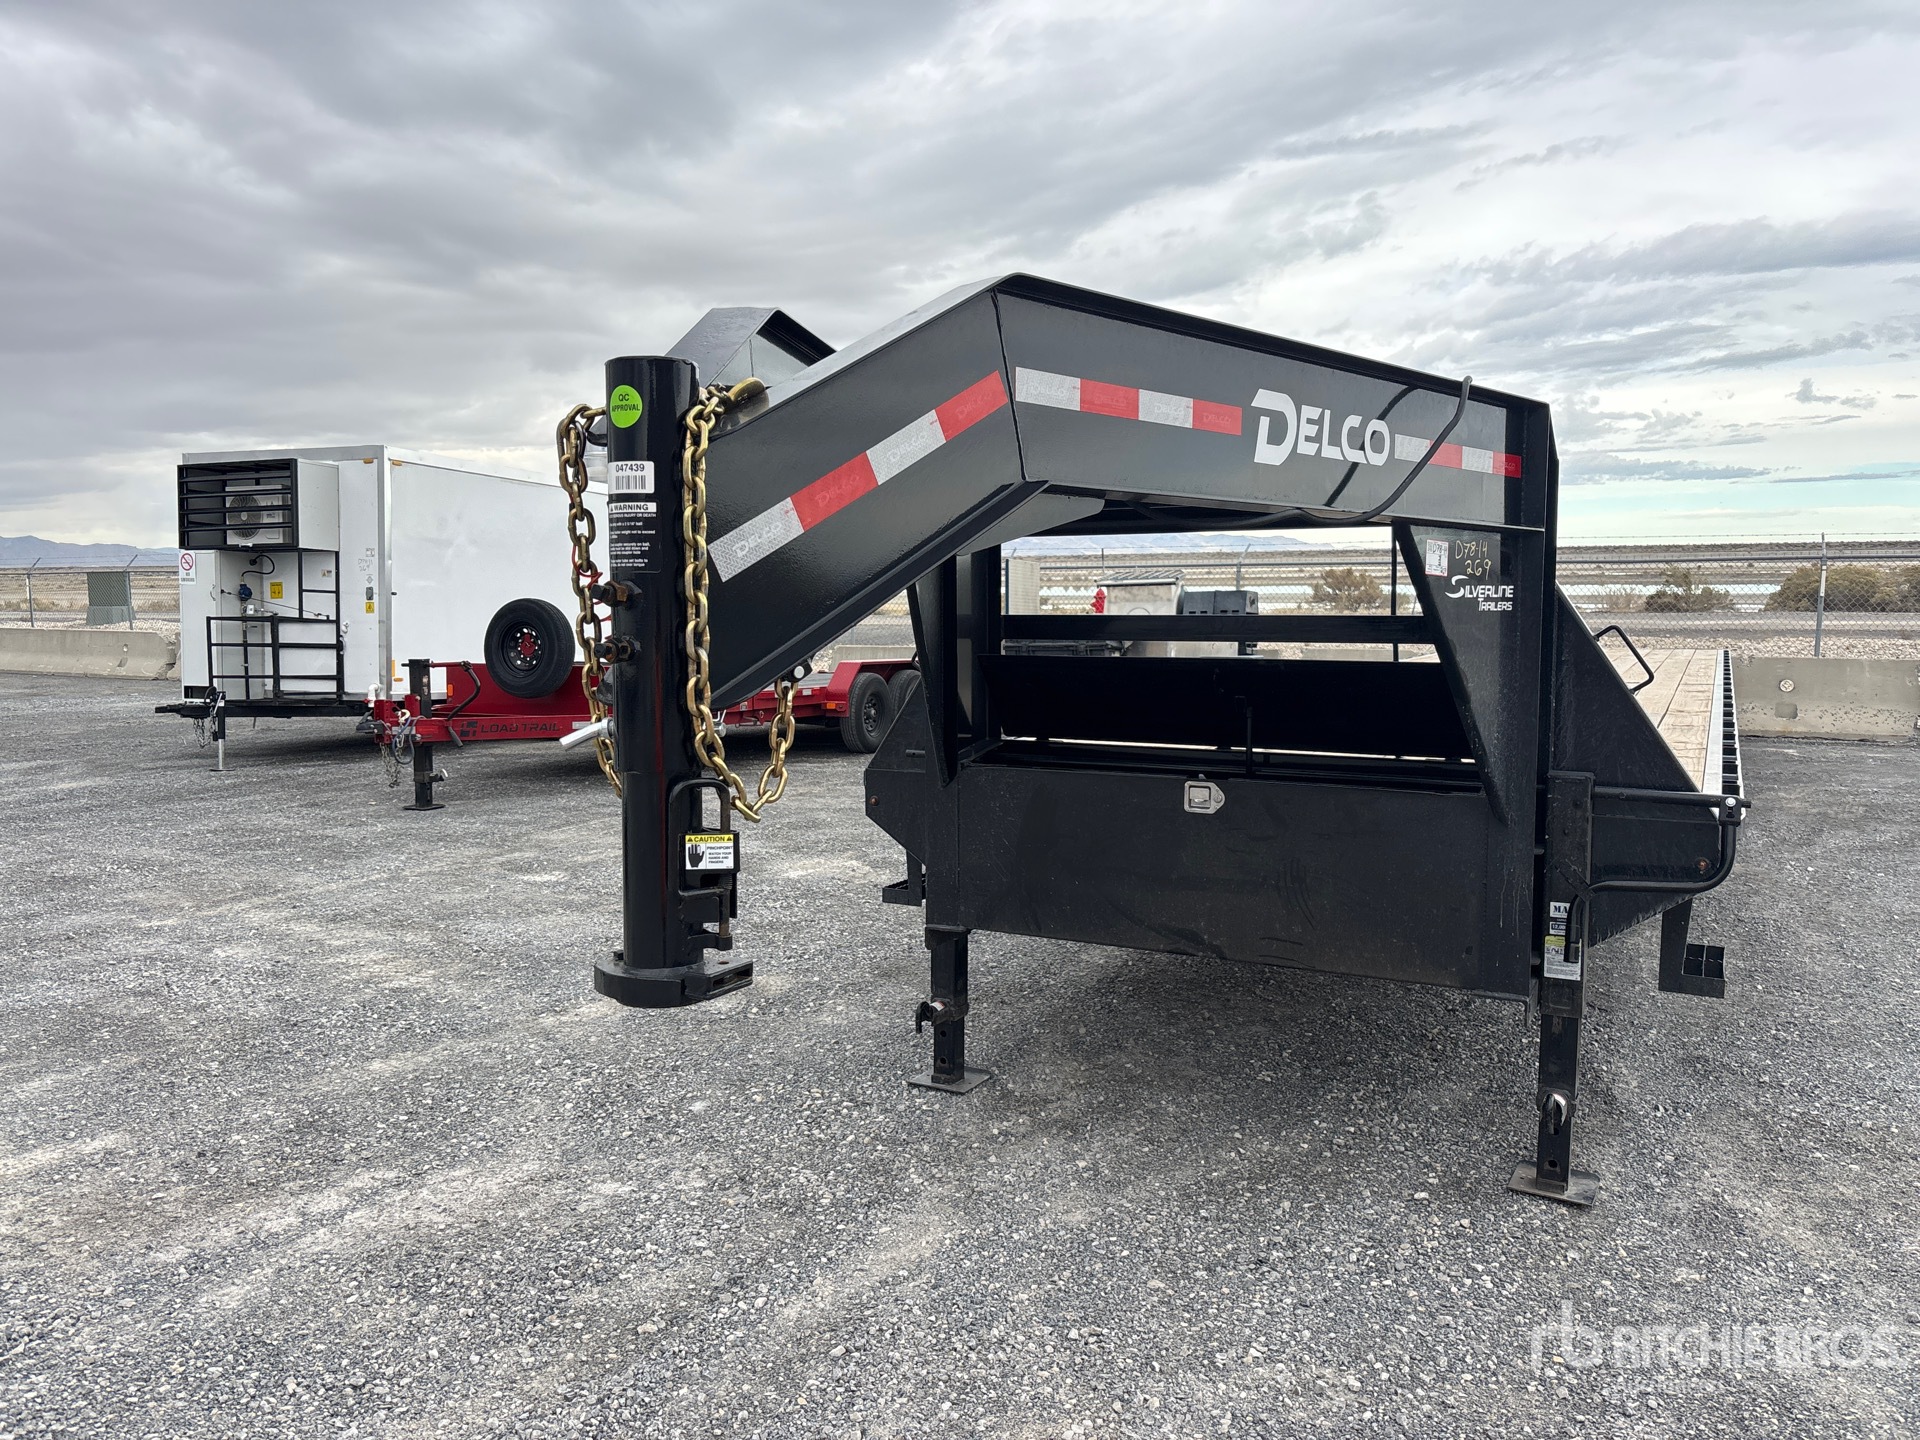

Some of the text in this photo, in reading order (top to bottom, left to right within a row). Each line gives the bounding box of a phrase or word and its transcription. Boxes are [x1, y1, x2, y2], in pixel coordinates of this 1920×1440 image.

[618, 393, 630, 402] QC
[611, 403, 641, 413] APPROVAL
[1250, 388, 1391, 466] DELCO
[615, 463, 645, 473] 047439
[613, 503, 649, 511] WARNING
[1455, 540, 1488, 559] D78-14
[1464, 559, 1492, 580] 269
[1444, 574, 1515, 598] SILVERLINE
[1477, 598, 1513, 612] TRAILERS
[480, 722, 560, 733] LOAD TRAIL
